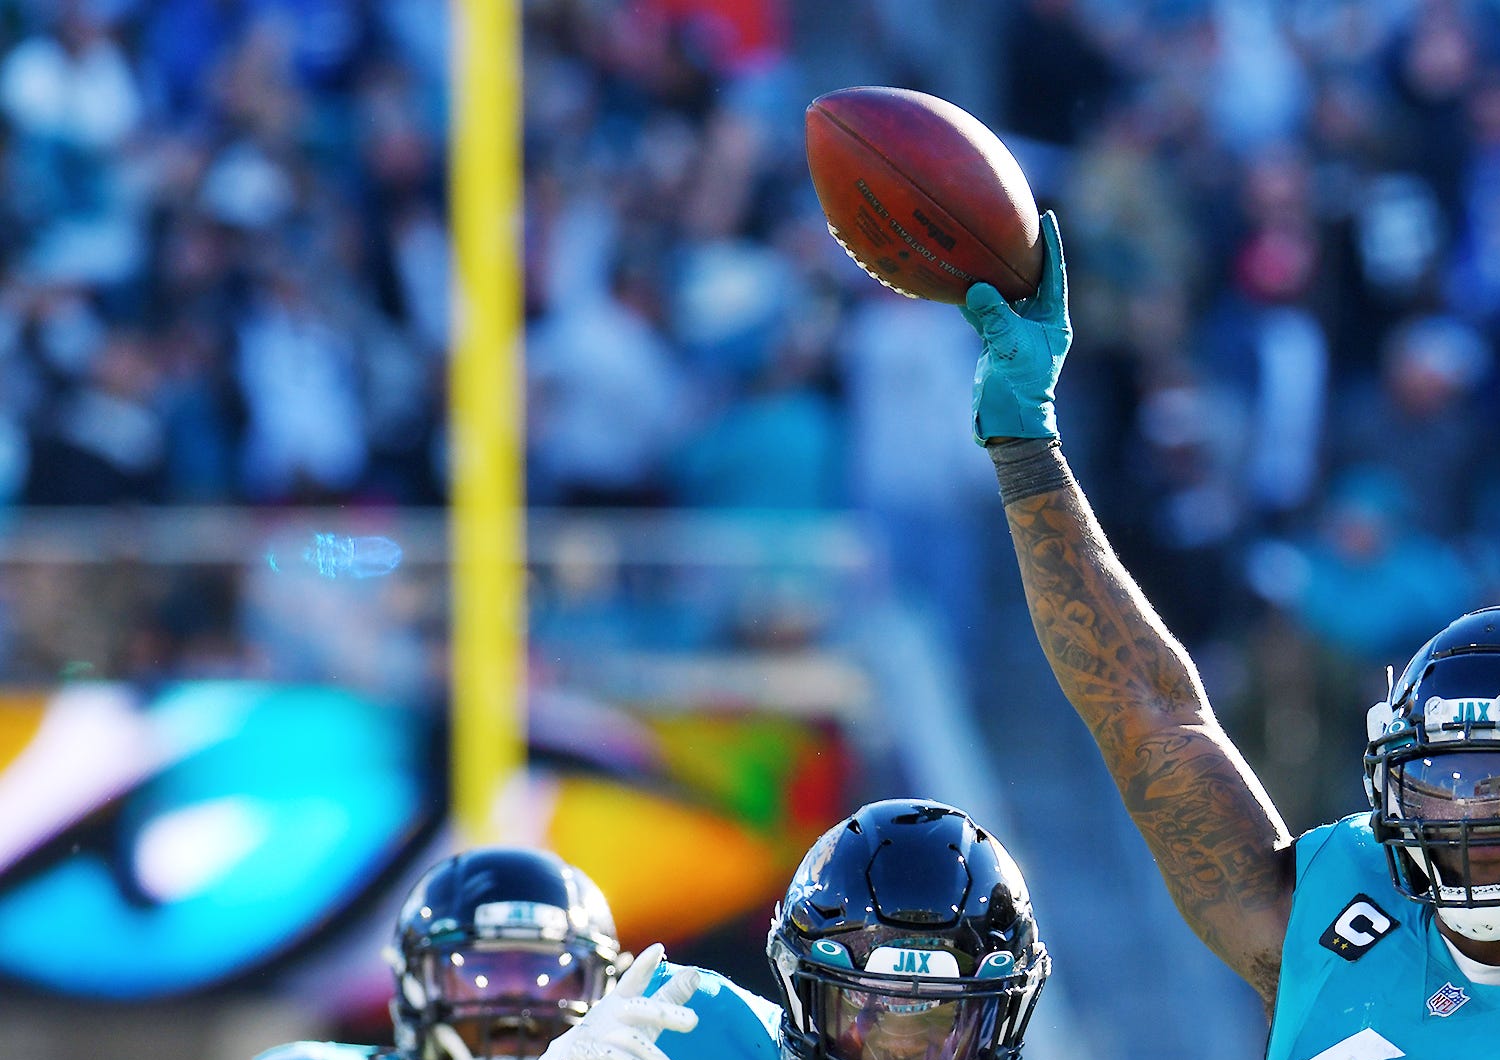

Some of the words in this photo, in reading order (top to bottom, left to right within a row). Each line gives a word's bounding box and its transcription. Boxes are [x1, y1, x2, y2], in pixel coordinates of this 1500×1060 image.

[855, 178, 889, 220] LEAGUE
[889, 218, 937, 262] FOOTBALL
[938, 260, 977, 282] TIONAL
[1453, 701, 1490, 722] JAX
[1334, 901, 1391, 947] C
[893, 951, 931, 973] JAX
[1432, 994, 1454, 1012] NFL
